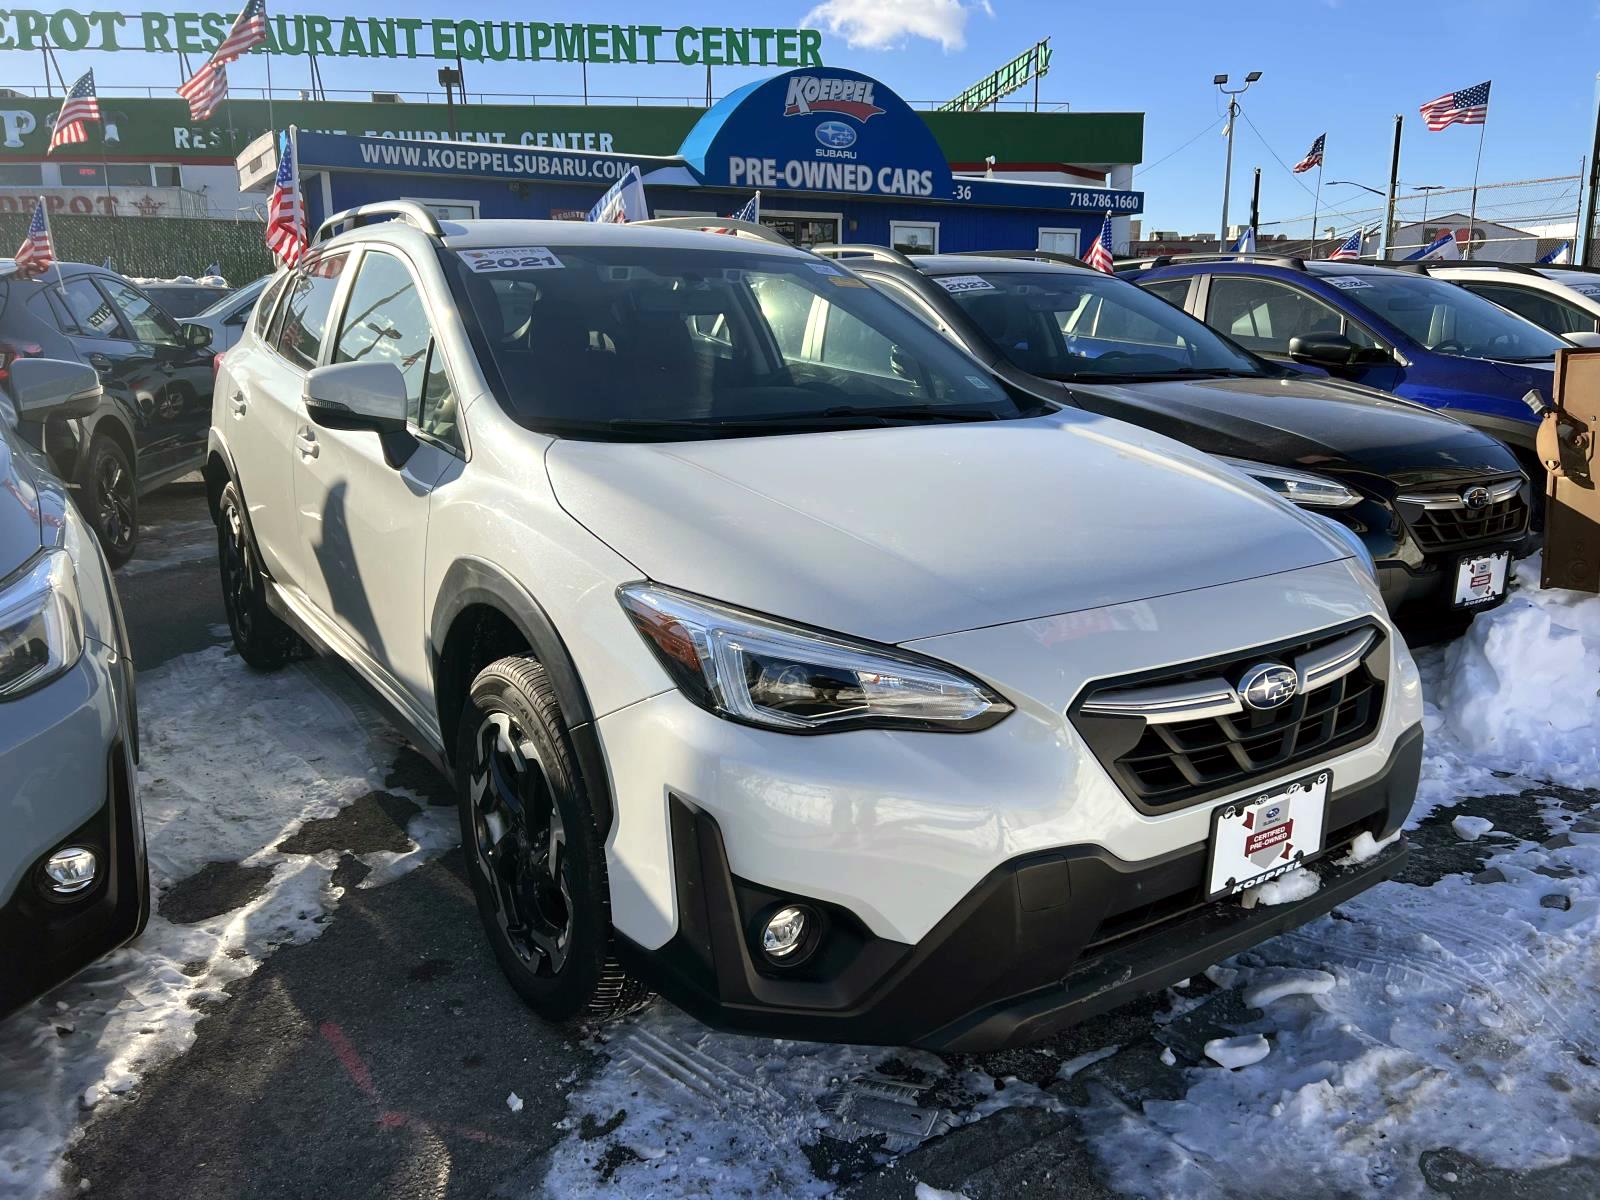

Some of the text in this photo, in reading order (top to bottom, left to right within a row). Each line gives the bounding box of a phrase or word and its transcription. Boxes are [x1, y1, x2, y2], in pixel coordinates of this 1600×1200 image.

[432, 19, 662, 65] EQUIPMENT
[675, 26, 823, 68] CENTER
[785, 76, 875, 116] KOEPPEL
[360, 143, 630, 178] WWW.KOEPPELSUBARU.COM
[815, 148, 857, 159] SUBARU
[729, 156, 933, 196] PRE-OWNED CARS
[1070, 192, 1138, 209] 718.786.1660
[474, 256, 556, 270] 2021
[1249, 832, 1288, 851] PRE-OWNED
[1253, 826, 1286, 843] CERTIFIED
[1232, 861, 1302, 894] KOEPPEL
